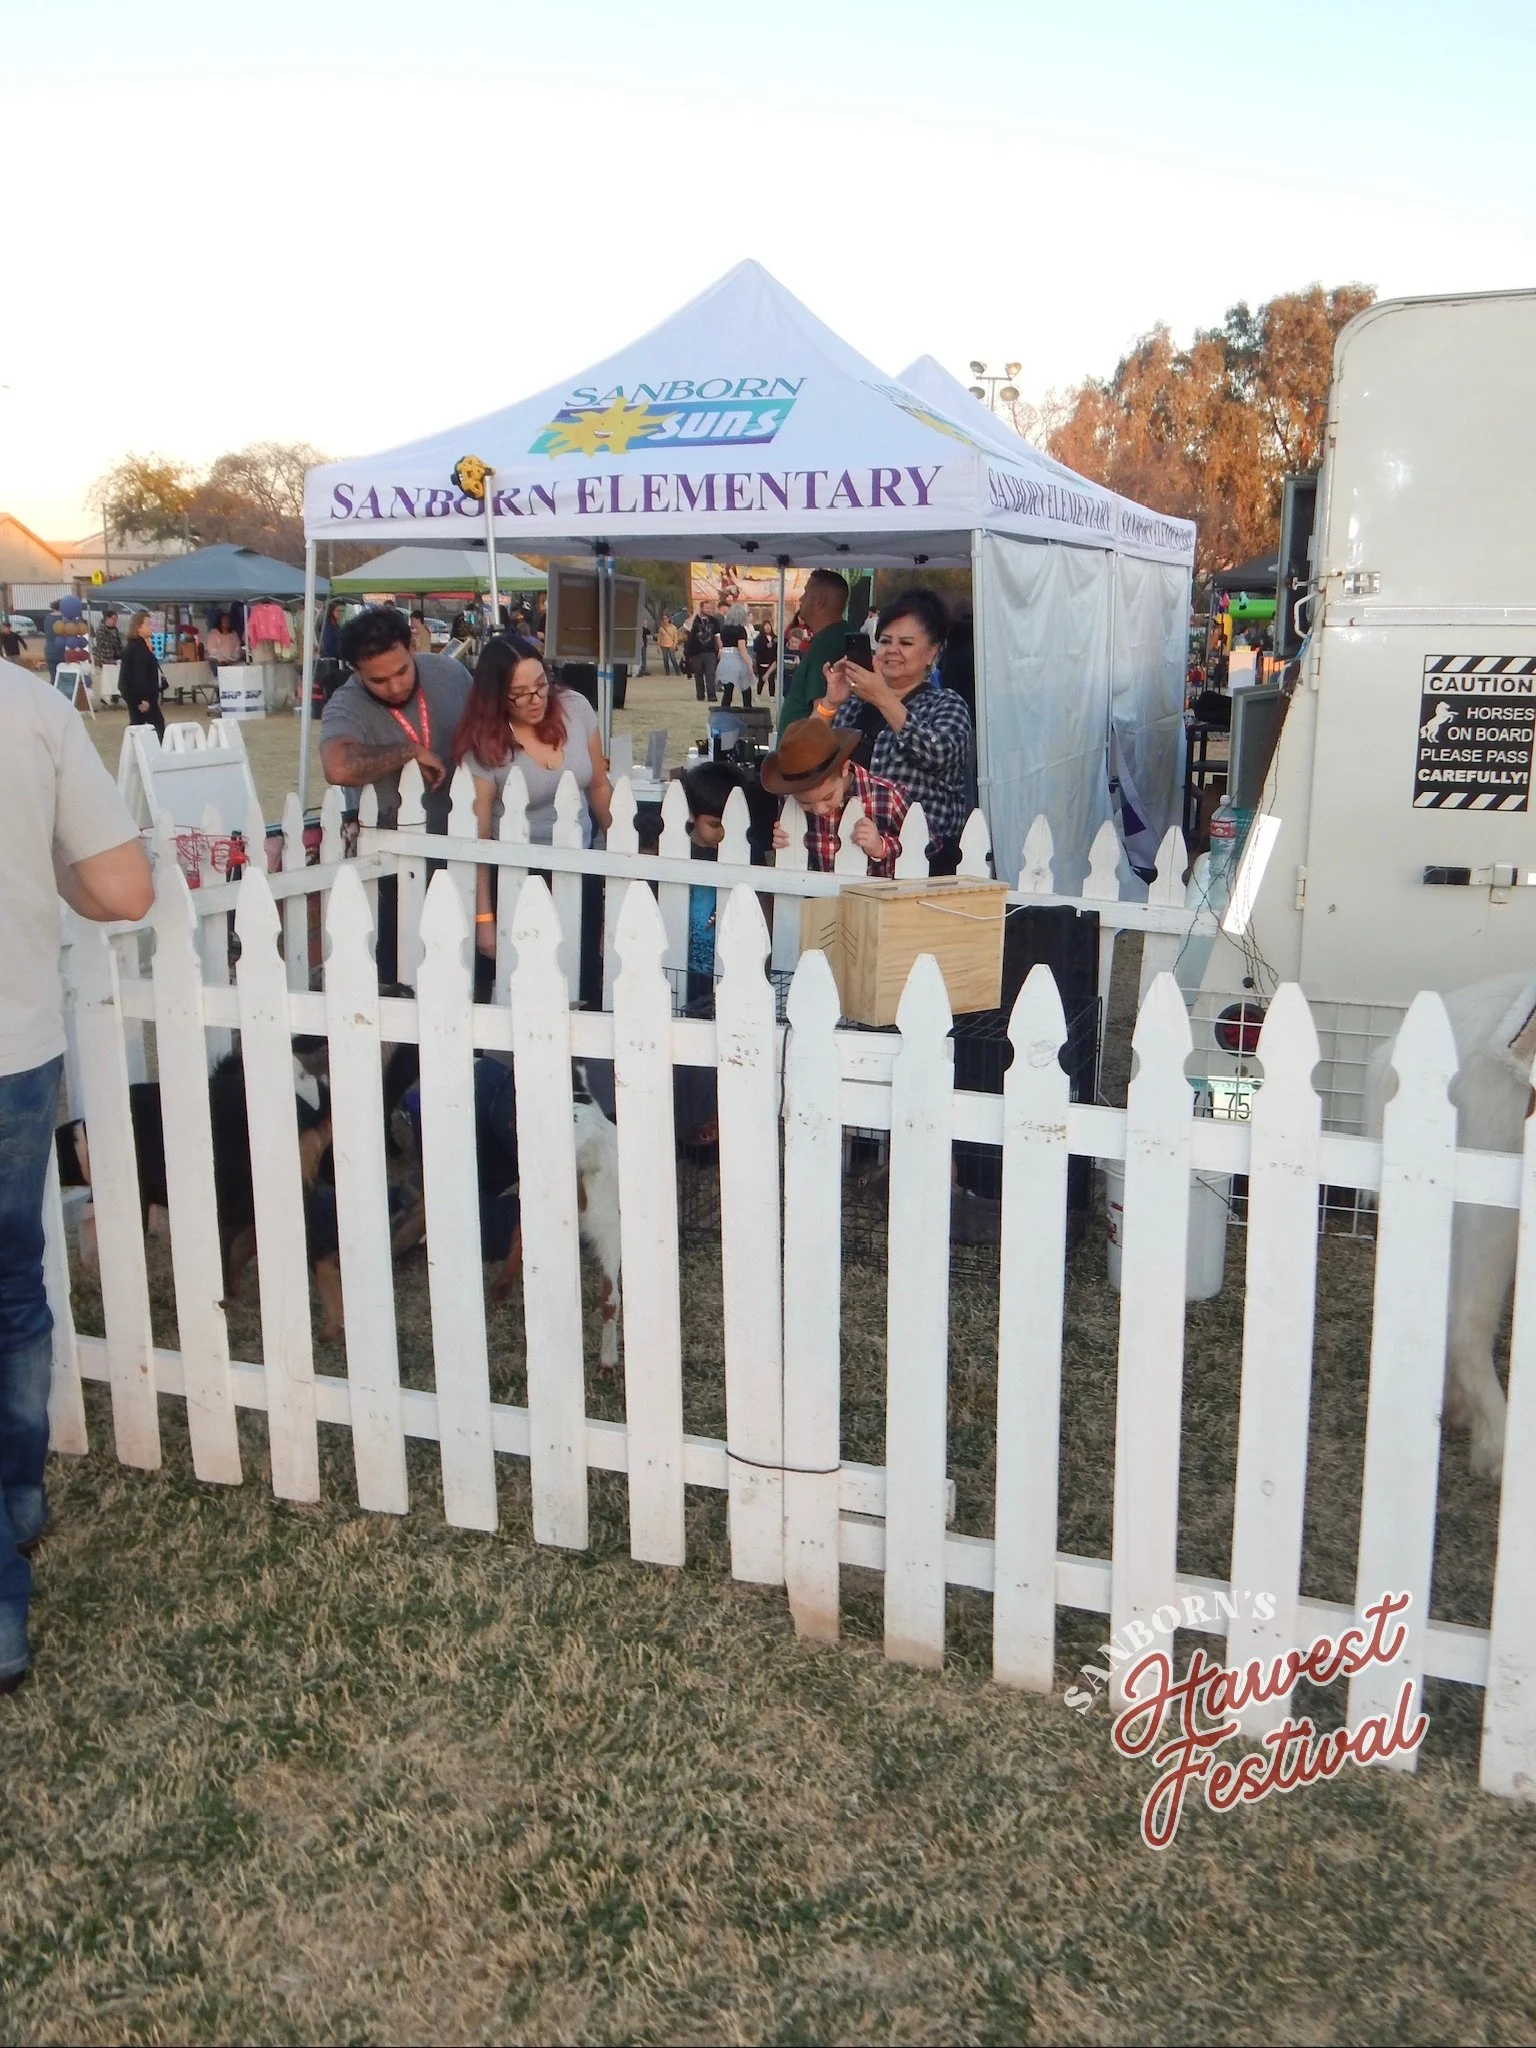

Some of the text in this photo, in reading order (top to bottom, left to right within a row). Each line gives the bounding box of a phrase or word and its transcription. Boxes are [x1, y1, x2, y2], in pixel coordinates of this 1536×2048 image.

[564, 377, 807, 407] SANBORN
[330, 464, 945, 520] SANBORN ELEMENTARY
[1429, 676, 1534, 693] CAUTION
[1466, 706, 1535, 721] HORSES
[1447, 726, 1533, 742] ON BOARD
[1420, 748, 1529, 763] PLEASE PASS
[1417, 768, 1529, 785] CAREFULLY!
